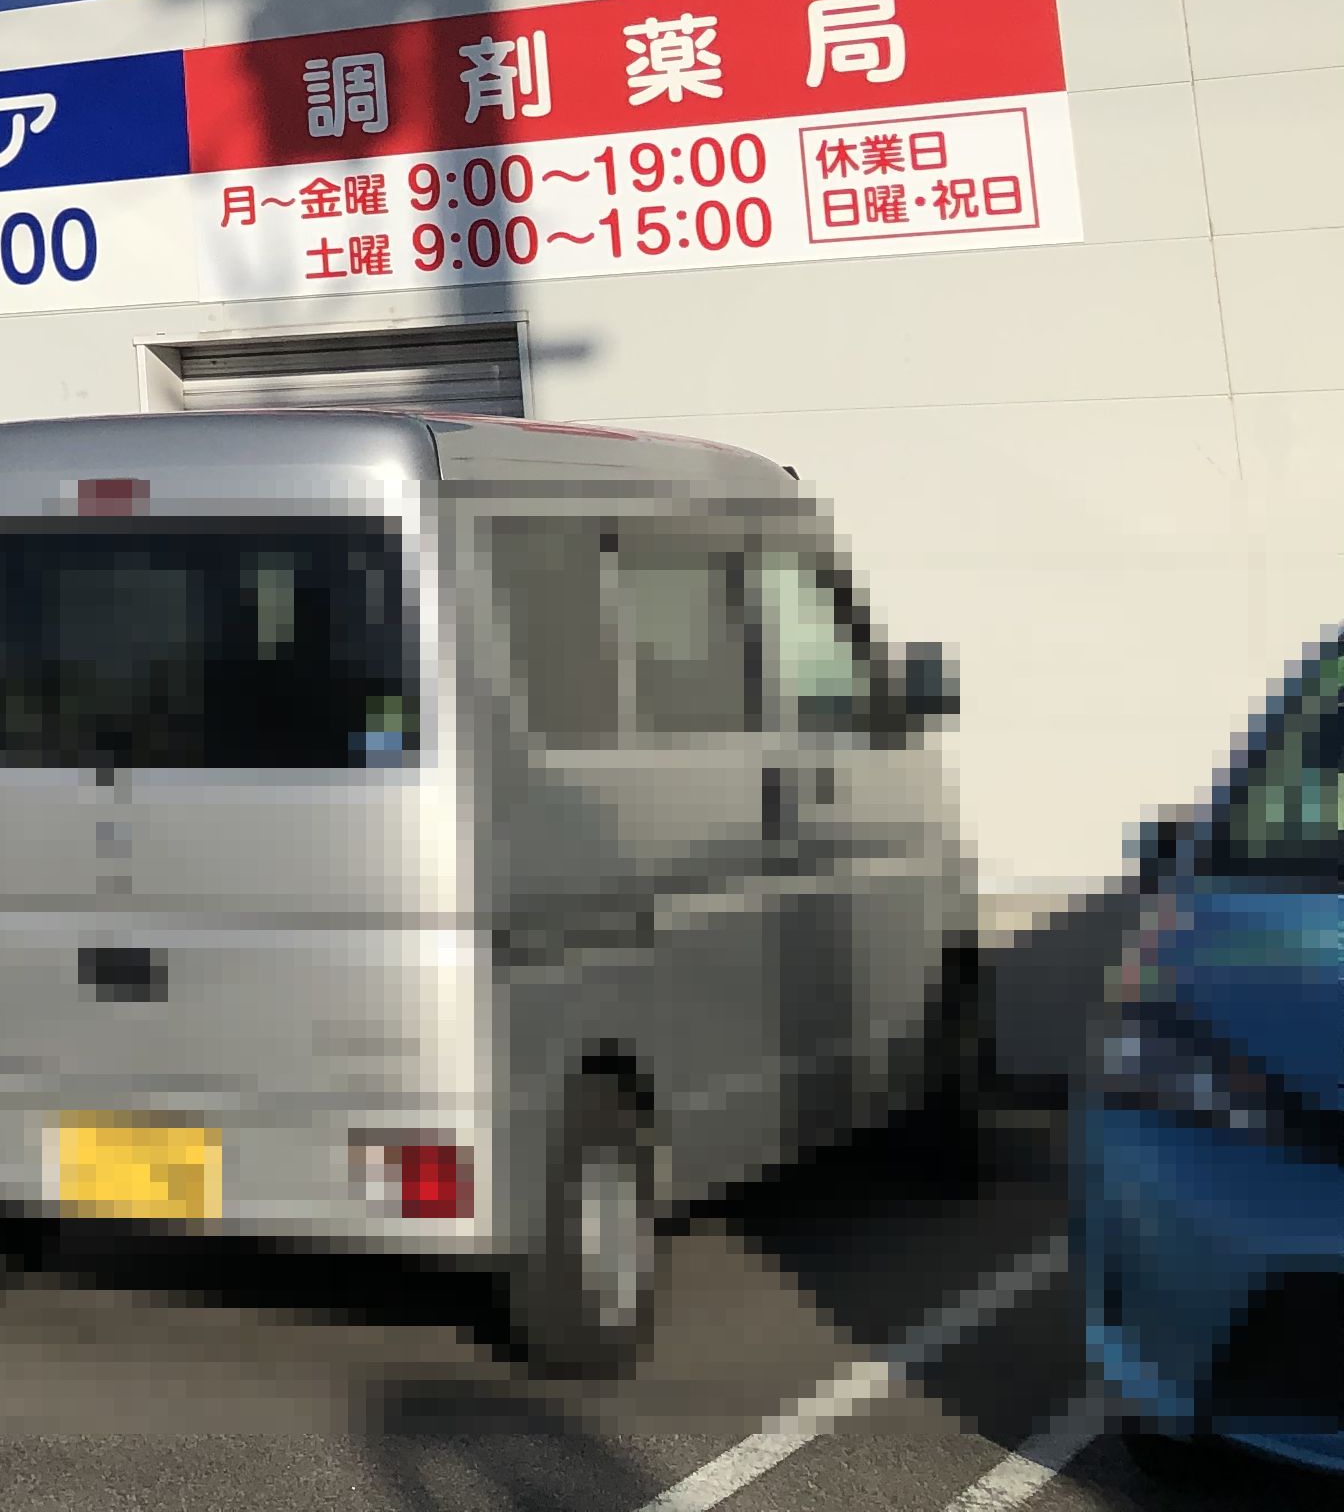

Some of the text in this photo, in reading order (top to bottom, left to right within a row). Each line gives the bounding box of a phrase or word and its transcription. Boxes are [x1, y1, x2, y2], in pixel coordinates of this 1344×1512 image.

[815, 131, 948, 179] 休業日
[823, 175, 1023, 228] 日曜・祝日
[305, 233, 394, 280] 土曜
